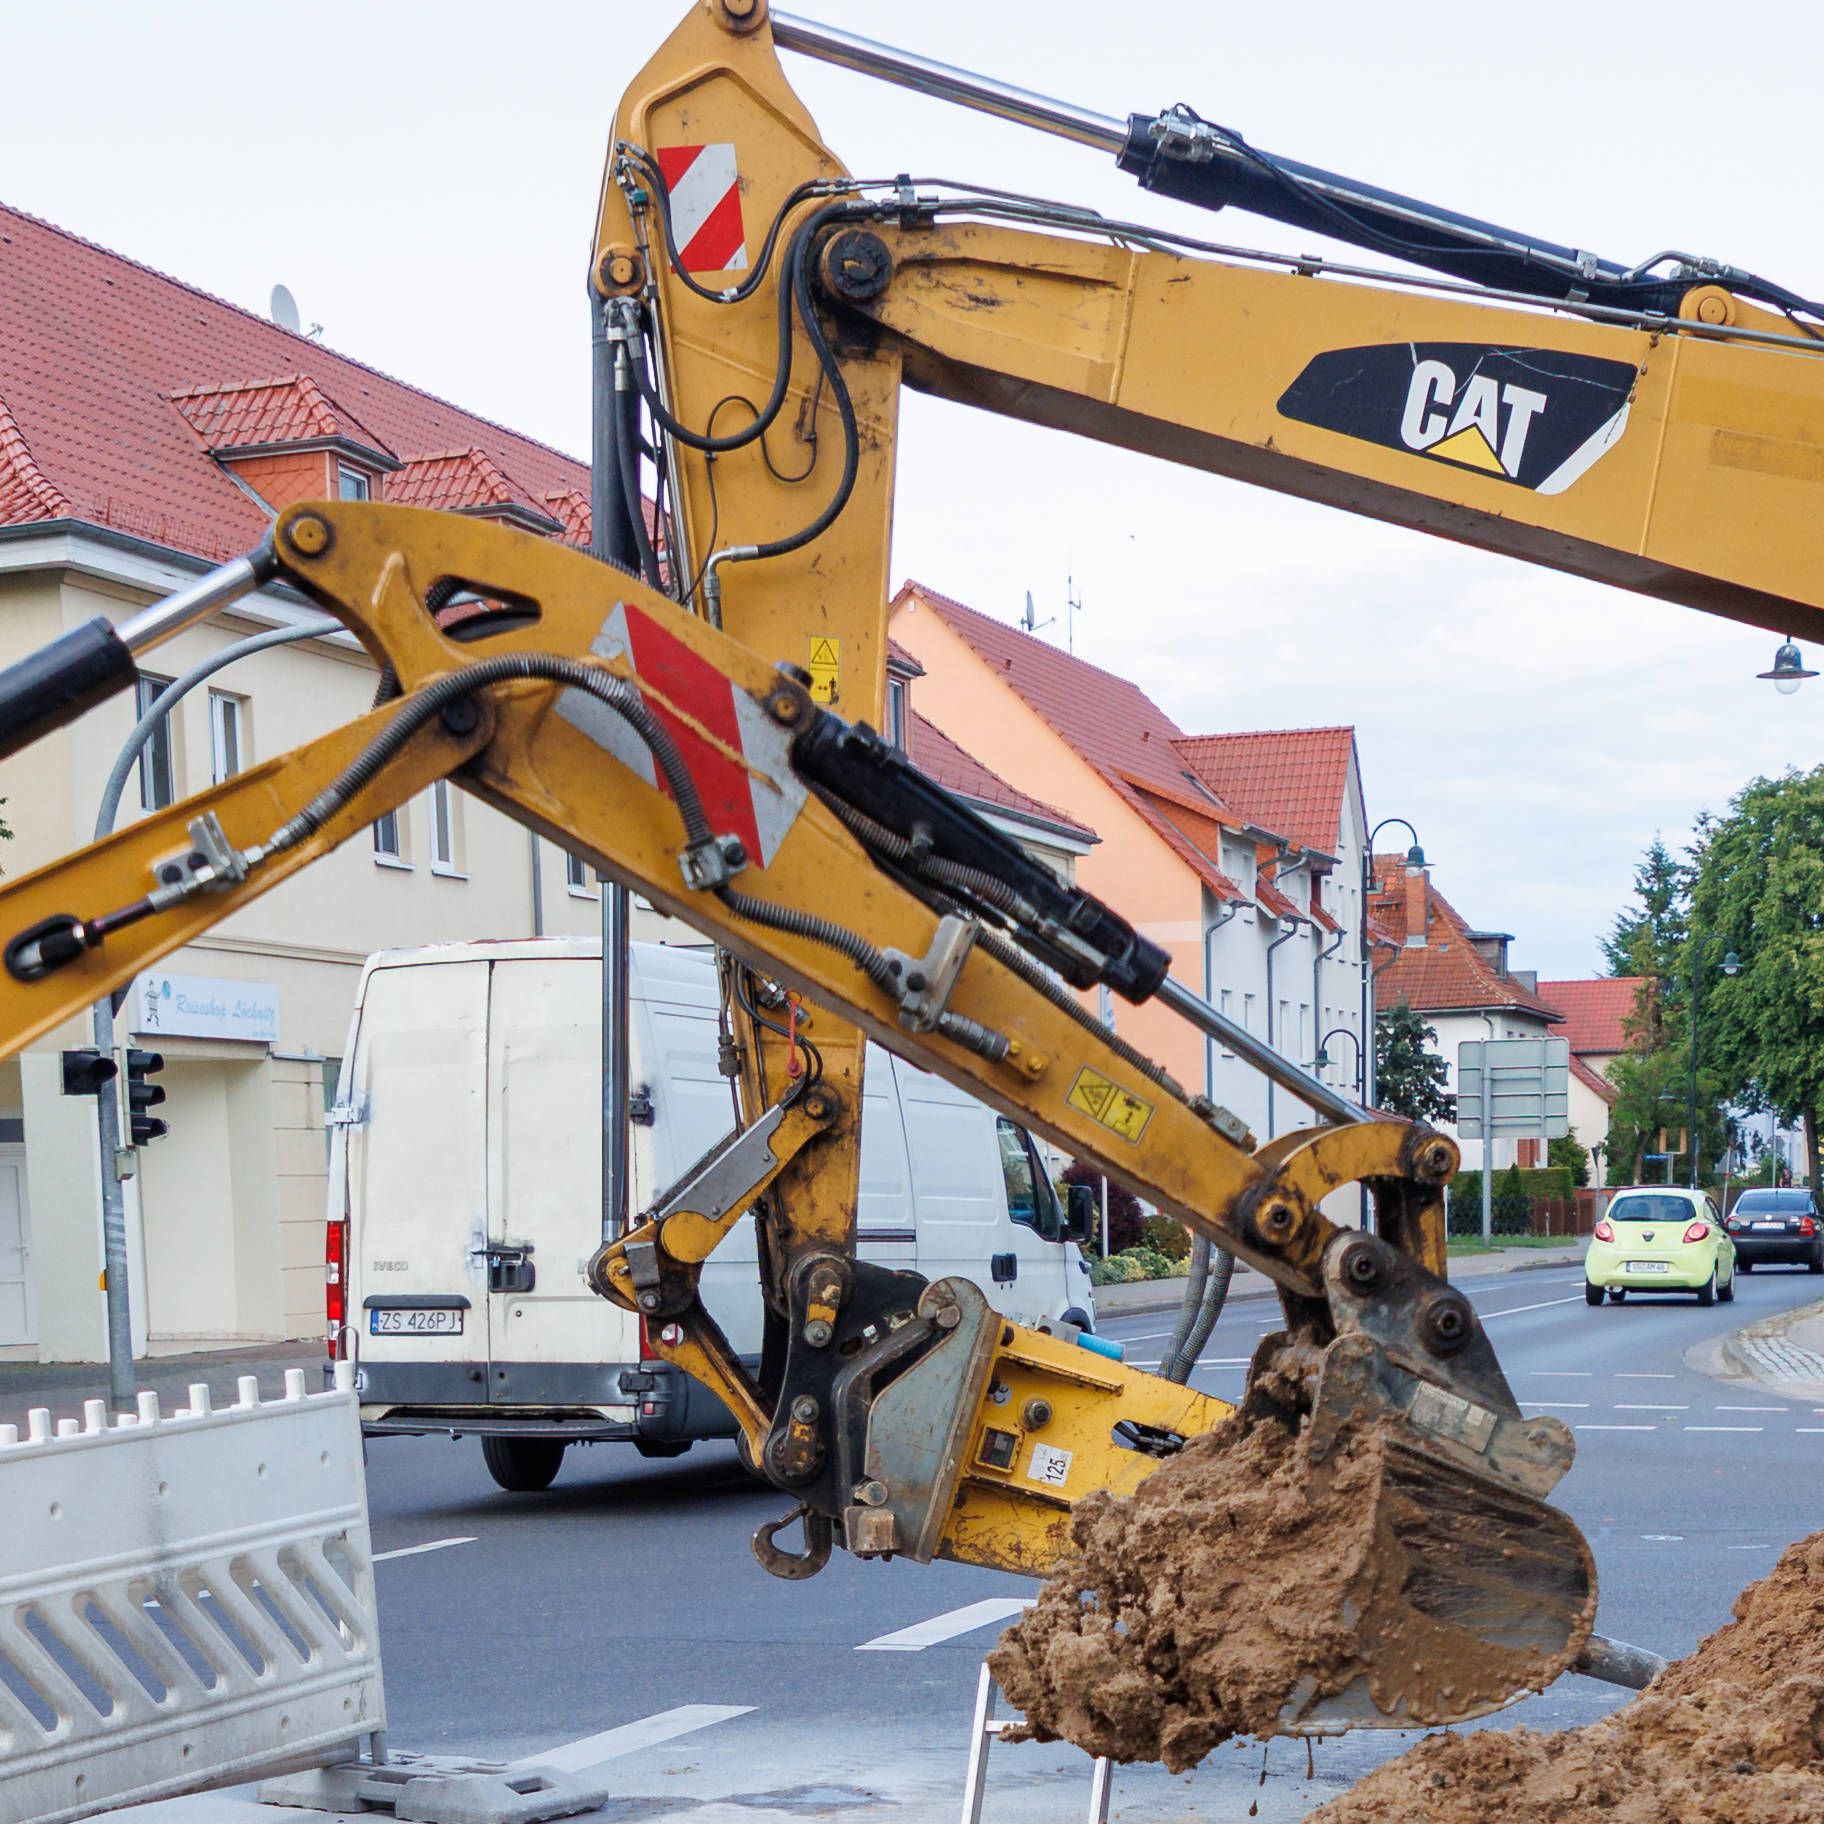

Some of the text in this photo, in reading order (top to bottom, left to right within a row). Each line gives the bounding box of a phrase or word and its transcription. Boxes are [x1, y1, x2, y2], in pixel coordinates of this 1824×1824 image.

[1400, 360, 1547, 478] CAT
[373, 1260, 409, 1272] IVECO
[382, 1312, 401, 1329] ZS
[1046, 1458, 1066, 1481] 125
